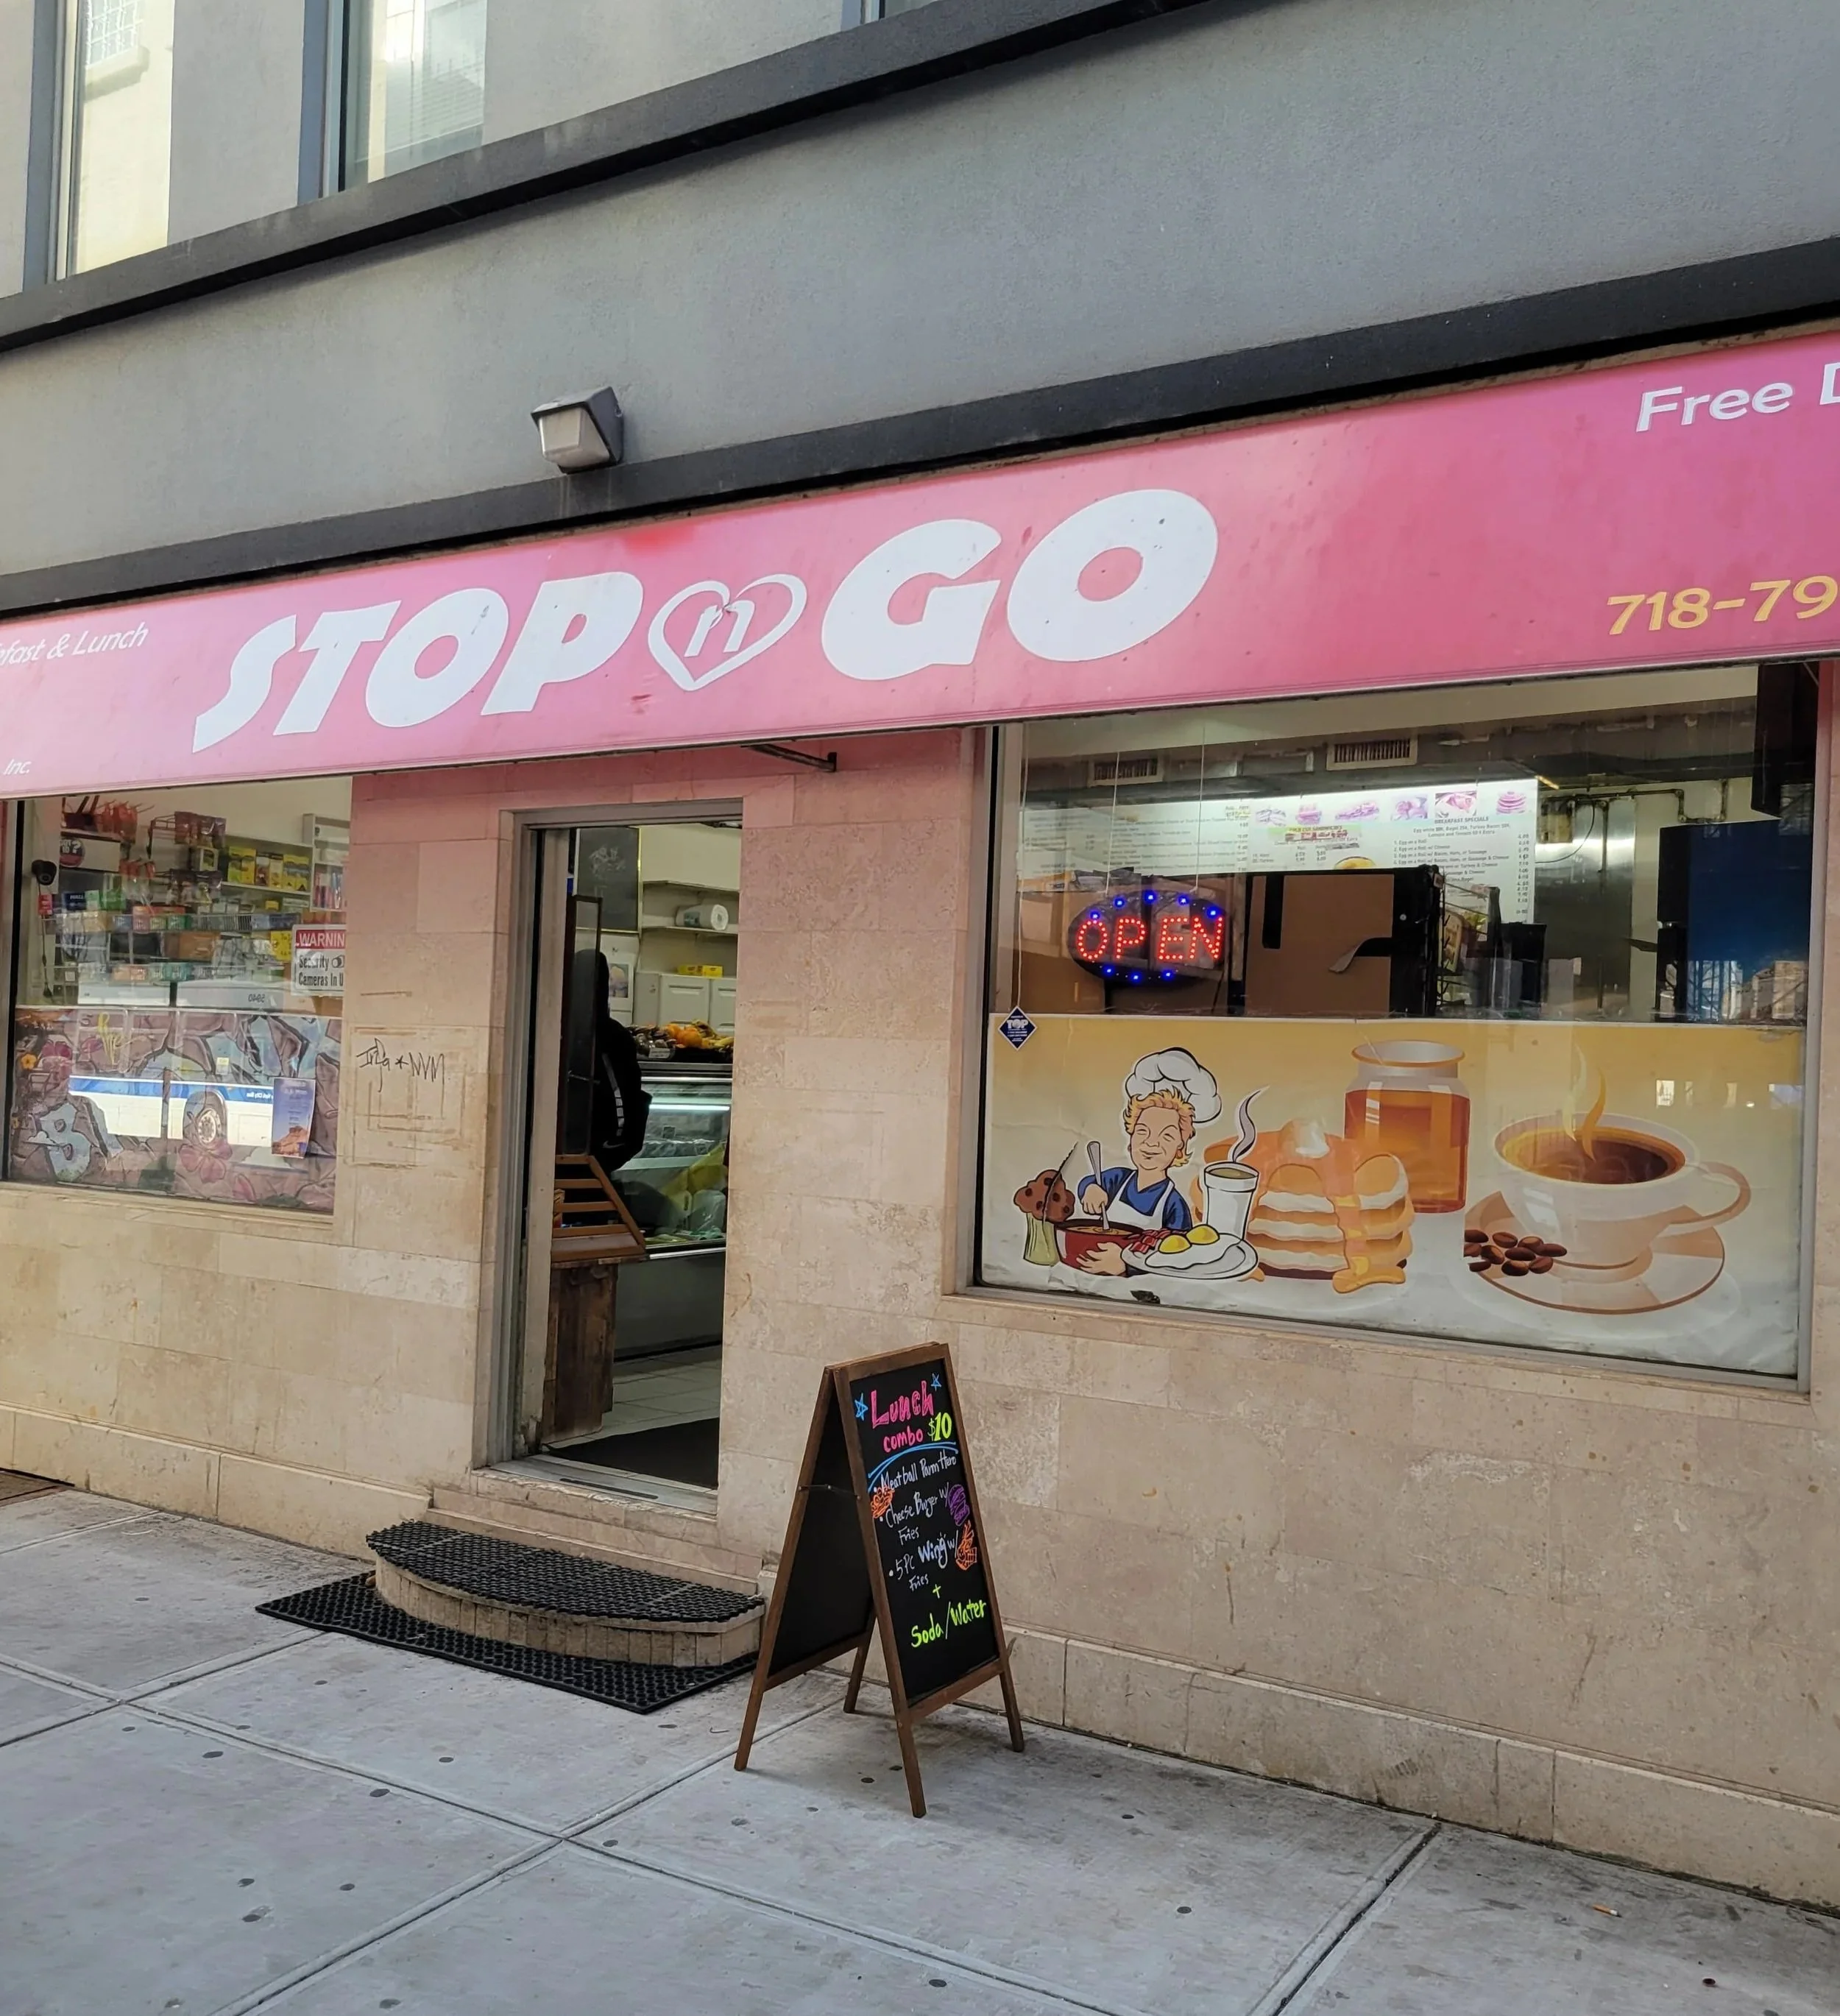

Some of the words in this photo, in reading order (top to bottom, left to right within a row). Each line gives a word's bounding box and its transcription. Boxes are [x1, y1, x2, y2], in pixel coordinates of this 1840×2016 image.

[1636, 381, 1794, 432] Free
[191, 571, 643, 754] STOP
[821, 489, 1218, 681] GO
[1607, 575, 1839, 635] 718-79
[46, 633, 71, 659] &
[71, 621, 149, 655] Lunch
[3, 759, 30, 776] Inc.
[299, 932, 345, 947] WARNIN
[1075, 914, 1225, 962] OPEN
[298, 972, 328, 986] Cameras
[330, 973, 337, 986] In
[1007, 1019, 1029, 1029] TOP
[871, 1380, 934, 1429] Lunch
[883, 1426, 924, 1453] combo
[927, 1412, 952, 1442] $10
[880, 1463, 918, 1492] Meatball
[920, 1454, 939, 1478] Parm
[940, 1449, 957, 1469] Hero
[885, 1502, 915, 1528] Cheese
[913, 1491, 938, 1518] Burger
[898, 1526, 919, 1545] Fries
[909, 1573, 929, 1592] Fries
